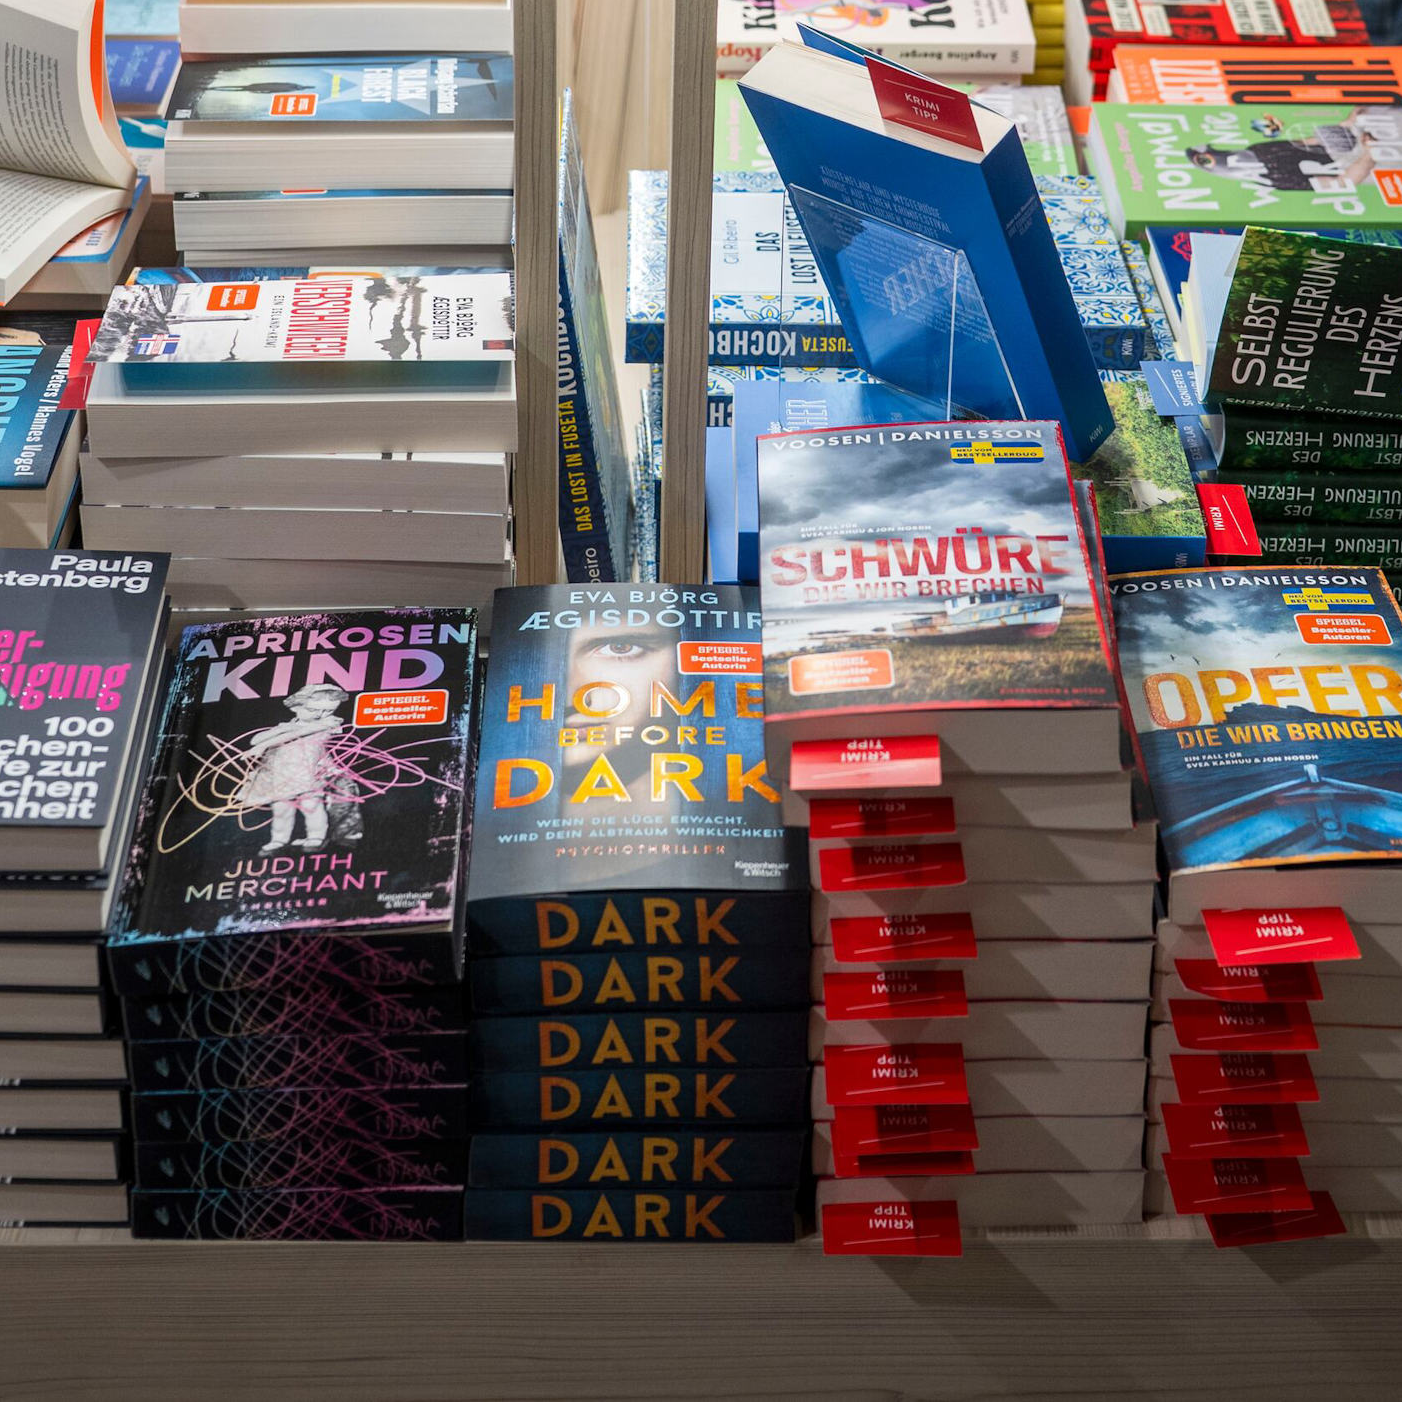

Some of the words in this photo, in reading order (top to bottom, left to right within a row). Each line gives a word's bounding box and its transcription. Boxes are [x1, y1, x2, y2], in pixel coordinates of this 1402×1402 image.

[361, 67, 394, 104] FOREST
[397, 68, 428, 101] BLACK
[904, 92, 941, 113] KRIMI
[911, 106, 939, 122] TIPP
[755, 231, 781, 252] DAS
[791, 258, 818, 284] LOST
[272, 294, 286, 306] EIN
[455, 296, 474, 311] EVA
[264, 307, 282, 350] ISLAND-KRIMI
[282, 279, 355, 360] VERSCHWIEGEN
[431, 295, 452, 341] ÆGISDÓTTIR
[454, 311, 475, 339] BJÖRG
[1272, 248, 1347, 390] REGULIERUNG
[1325, 304, 1369, 343] DES
[1231, 292, 1283, 387] SELBST
[44, 369, 71, 399] Peters
[1171, 368, 1194, 408] SIGNIERTES
[24, 405, 57, 443] Hannes
[559, 400, 581, 454] FUSETA
[771, 433, 873, 452] VOOSEN
[890, 428, 1043, 443] DANIELSSON
[12, 444, 45, 478] Vogel
[956, 451, 1039, 459] BESTSELLERDUO
[1246, 484, 1316, 501] HERZEN
[1283, 505, 1313, 517] DES
[49, 553, 154, 574] Paula
[769, 526, 1072, 587] SCHWÜRE
[855, 581, 909, 601] WIR
[917, 576, 1045, 599] BRECHEN
[1221, 574, 1368, 588] DANIELSSON
[569, 590, 616, 605] EVA
[629, 587, 719, 605] BJÖRG
[1289, 597, 1369, 606] BESTSELLERDUO
[1310, 626, 1377, 636] Bestseller-
[1315, 617, 1366, 628] SPIEGEL
[185, 622, 471, 662] APRIKOSEN
[1322, 633, 1372, 643] Autoren
[690, 654, 757, 664] Bestseller-
[697, 645, 748, 656] SPIEGEL
[201, 648, 446, 704] KIND
[701, 662, 748, 671] Autorin
[363, 704, 440, 715] Bestseller-
[373, 695, 430, 706] SPIEGEL
[506, 680, 765, 723] HOME
[44, 716, 115, 738] 100
[373, 711, 427, 722] Autorin
[557, 724, 727, 748] BEFORE
[846, 739, 885, 752] TIPP
[1175, 727, 1221, 750] DIE
[1227, 723, 1281, 745] WIR
[840, 750, 891, 763] KRIMI
[1183, 755, 1201, 763] EIN
[1202, 753, 1223, 761] FALL
[1224, 750, 1243, 759] FÜR
[1186, 761, 1209, 770] SVEA
[1210, 758, 1253, 768] KARHUU
[1262, 755, 1282, 764] JON
[1283, 753, 1320, 762] NORDH
[37, 759, 107, 778] zur
[492, 751, 783, 810] DARK
[536, 816, 585, 829] WENN
[591, 815, 617, 827] DIE
[622, 813, 666, 826] LÜGE
[497, 832, 540, 845] WIRD
[544, 829, 583, 841] DEIN
[589, 827, 669, 839] ALBTRAUM
[675, 826, 786, 839] WIRKLICHKEIT
[554, 844, 726, 857] PSYCHOTHRILLER
[224, 852, 353, 880] JUDITH
[184, 870, 389, 904] MERCHANT
[535, 898, 741, 949] DARK
[883, 914, 920, 925] TIPP
[1258, 913, 1294, 925] TIPP
[878, 925, 927, 938] KRIMI
[540, 956, 743, 1007] DARK
[876, 971, 911, 982] TIPP
[871, 982, 918, 995] KRIMI
[538, 1018, 739, 1067] DARK
[876, 1054, 912, 1066] TIPP
[871, 1067, 919, 1079] KRIMI
[539, 1073, 738, 1122] DARK
[538, 1136, 735, 1184] DARK
[531, 1193, 726, 1238] DARK
[874, 1205, 908, 1217] TIPP
[868, 1218, 915, 1231] KRIMI
